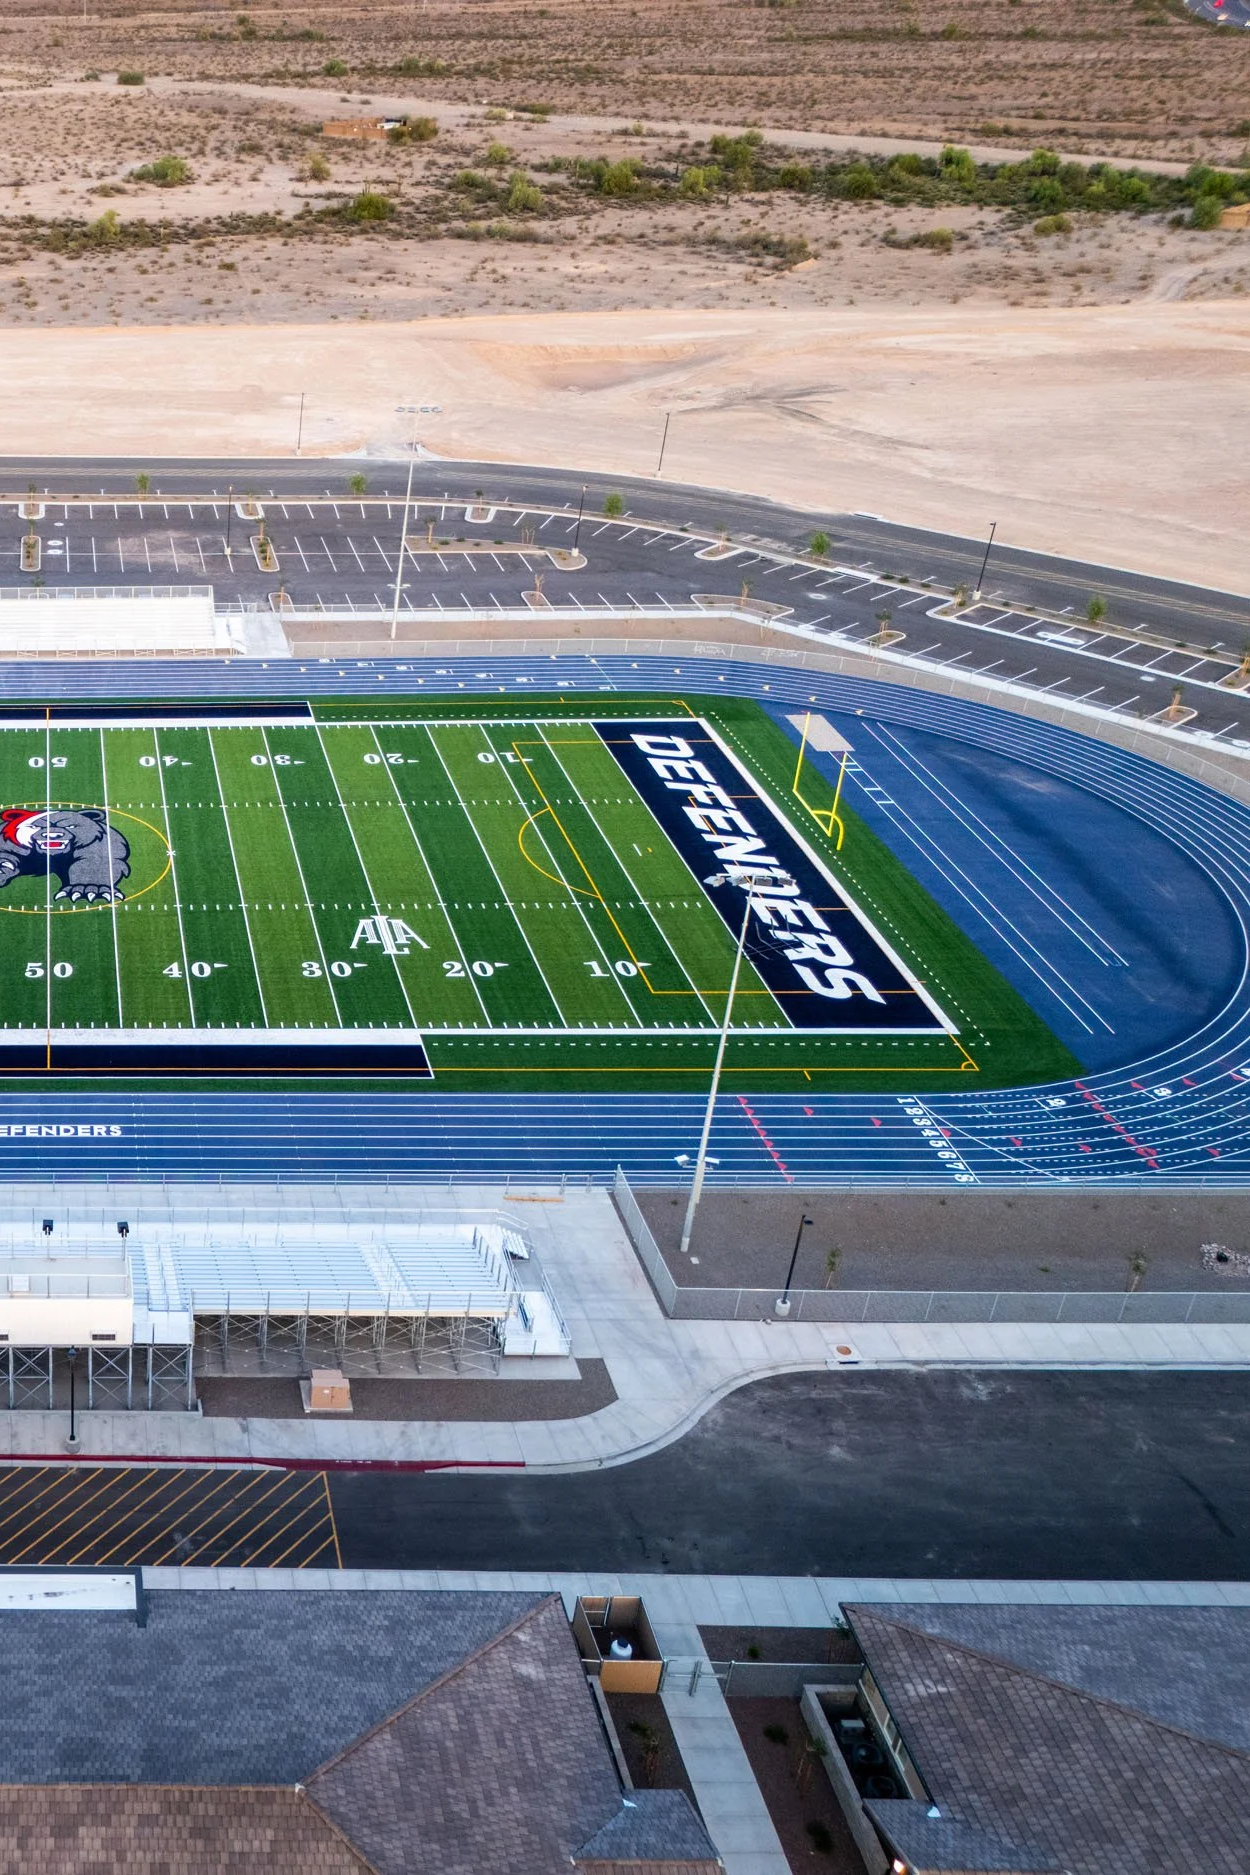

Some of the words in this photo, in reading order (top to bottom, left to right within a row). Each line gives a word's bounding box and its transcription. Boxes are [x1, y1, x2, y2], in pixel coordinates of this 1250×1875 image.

[28, 756, 68, 768] 50
[139, 755, 179, 767] 40
[250, 754, 291, 765] 30
[363, 753, 404, 764] 20
[477, 752, 521, 763] 10
[630, 732, 887, 1005] DEFENDERS
[24, 962, 73, 978] 50
[162, 961, 212, 978] 40
[301, 961, 352, 978] 30
[442, 960, 494, 977] 20
[583, 960, 638, 977] 10
